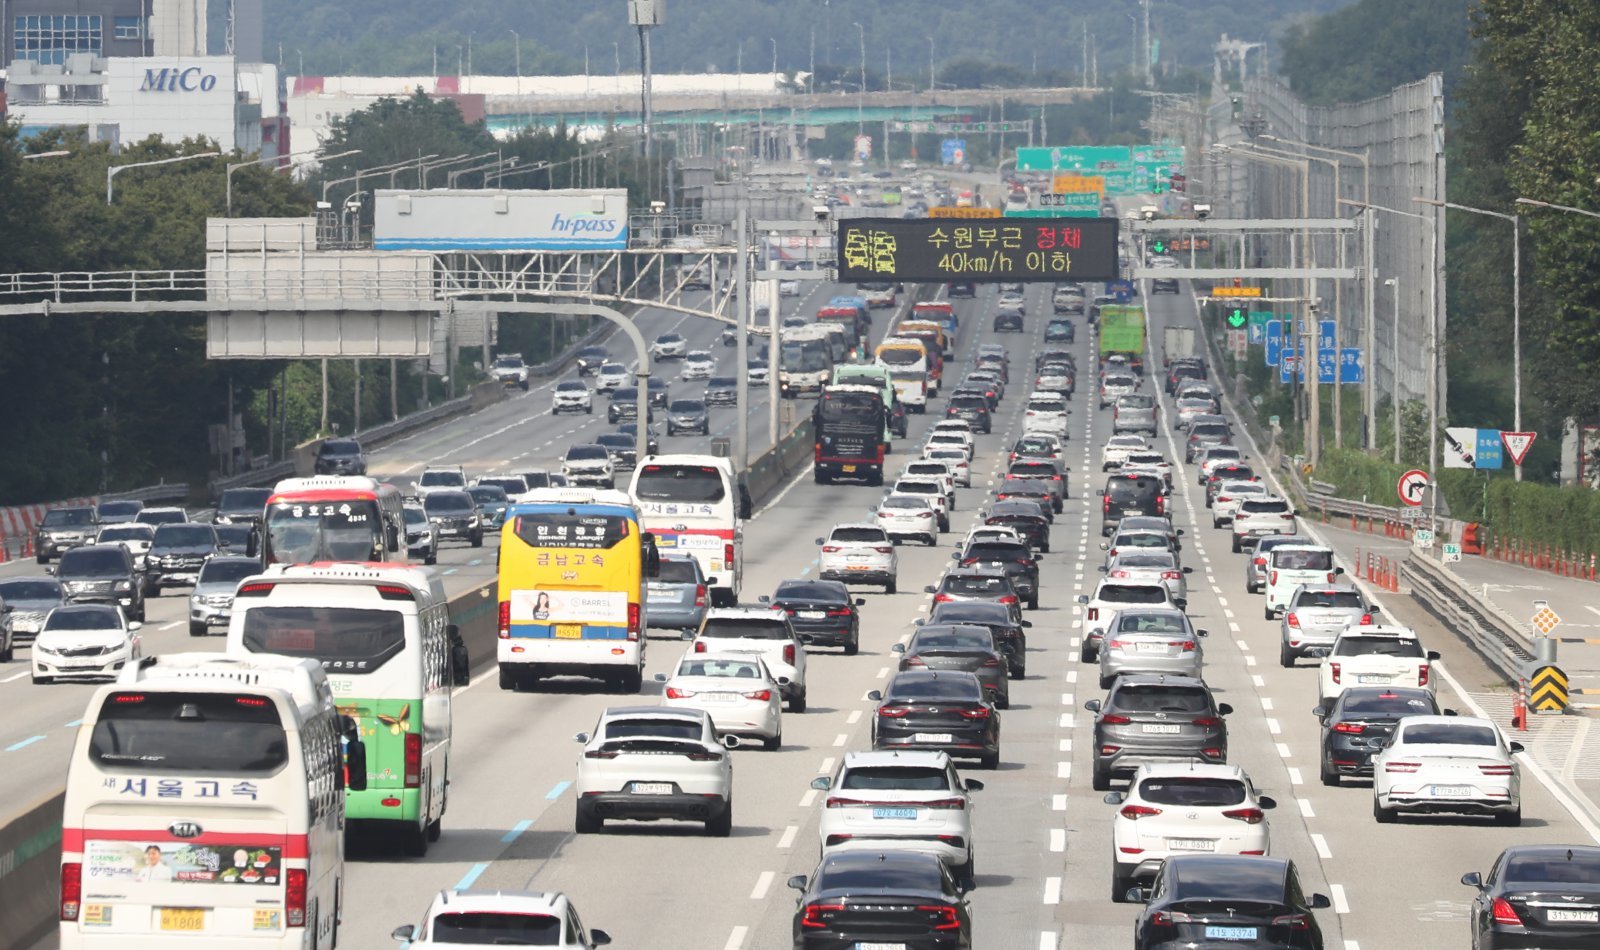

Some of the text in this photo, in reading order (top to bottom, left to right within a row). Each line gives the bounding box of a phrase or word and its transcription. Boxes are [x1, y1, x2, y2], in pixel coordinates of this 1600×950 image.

[139, 66, 217, 92] MiCo
[928, 227, 1081, 249] 수원부근 정체
[938, 250, 1072, 273] 40km/h 이하
[292, 504, 352, 518] 금호고속
[536, 552, 605, 568] 금남고속
[102, 777, 258, 800] 새 서울고속
[173, 822, 201, 837] KIA
